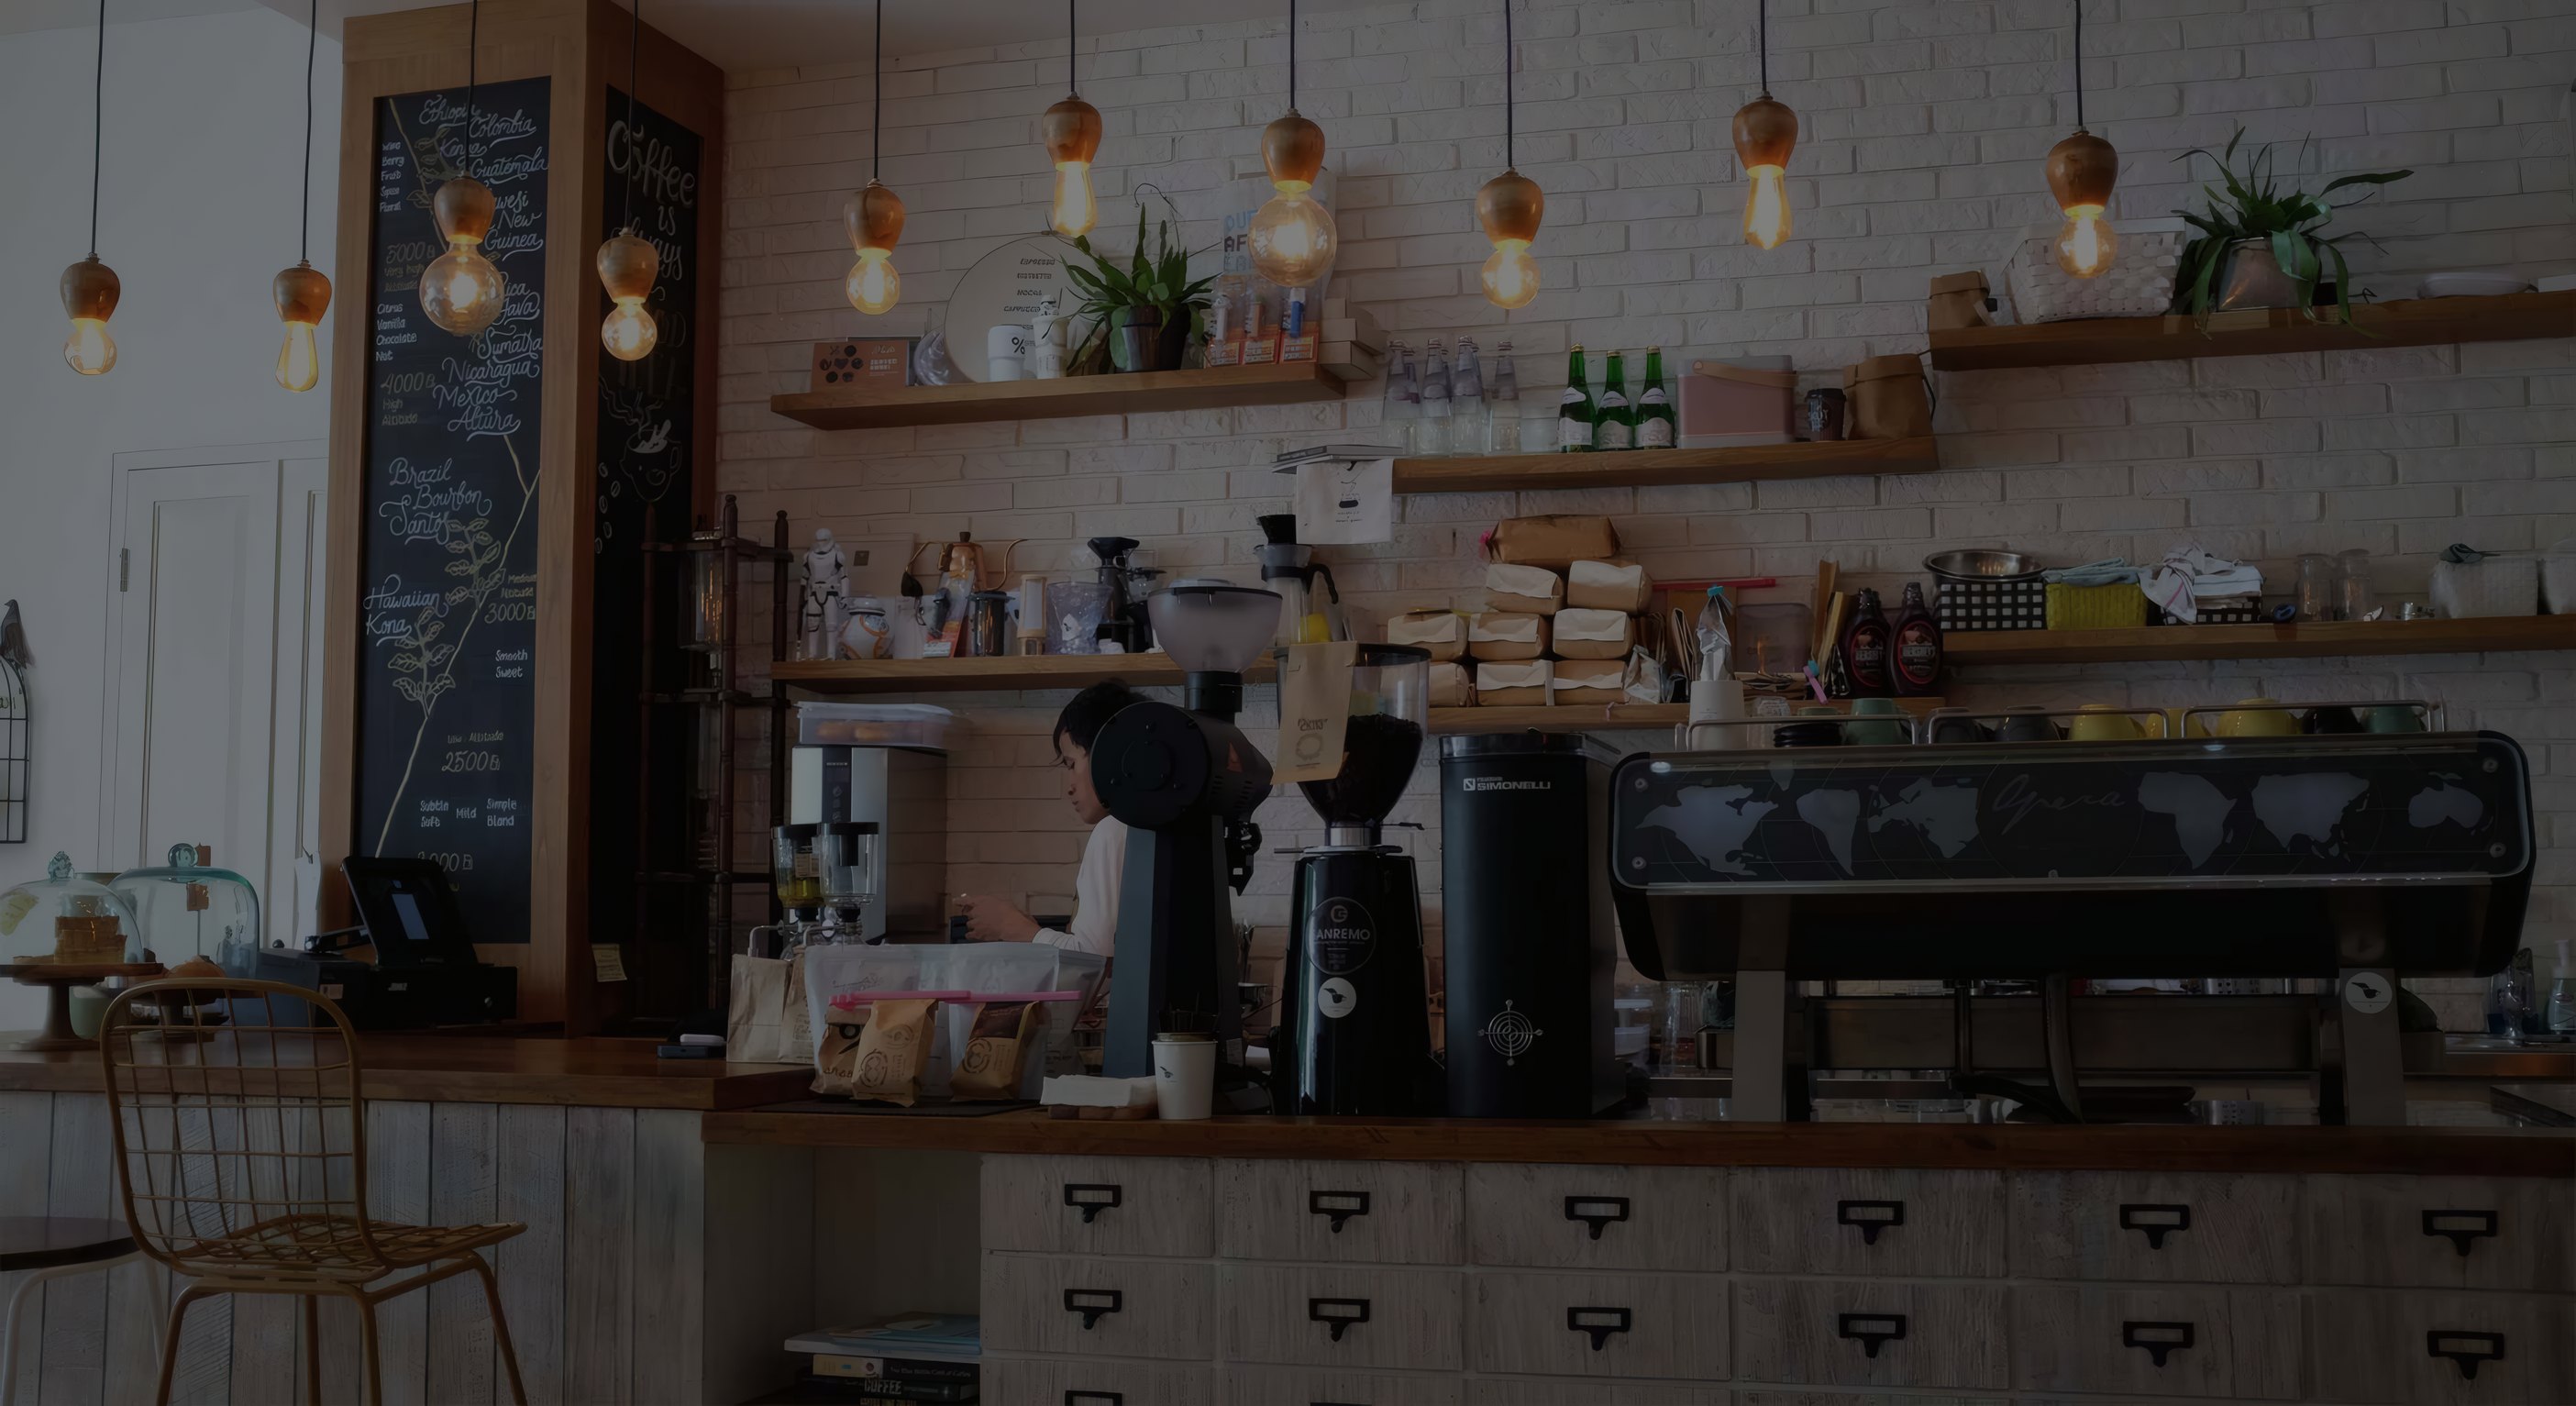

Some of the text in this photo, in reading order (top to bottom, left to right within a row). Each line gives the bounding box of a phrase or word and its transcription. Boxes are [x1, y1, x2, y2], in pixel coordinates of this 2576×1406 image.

[419, 94, 481, 127] Ethiopia
[470, 109, 536, 147] Colombia
[440, 138, 487, 167] Kenya
[470, 147, 548, 182] Guatemala
[607, 119, 695, 207] Coffee
[497, 210, 543, 229] New
[657, 205, 676, 237] is
[386, 242, 426, 264] 5000
[484, 227, 543, 260] Guinea
[494, 293, 540, 325] Java
[477, 325, 543, 361] Sumatra
[381, 371, 425, 394] 4000
[442, 357, 539, 388] Nicaragua
[433, 384, 517, 409] Mexico
[448, 405, 521, 441] Altura
[389, 457, 452, 489] Brazil
[413, 481, 492, 516] Bourbon
[380, 495, 449, 545] Santos
[363, 574, 449, 617] Hawaiian
[365, 612, 412, 646] Kona
[484, 602, 526, 624] 3000
[441, 750, 489, 773] 2500
[1476, 781, 1551, 792] SIMONELLI
[456, 808, 477, 819] Mild
[487, 814, 514, 827] Bland
[1315, 927, 1372, 941] ANREMO
[864, 1378, 902, 1395] COFFEE
